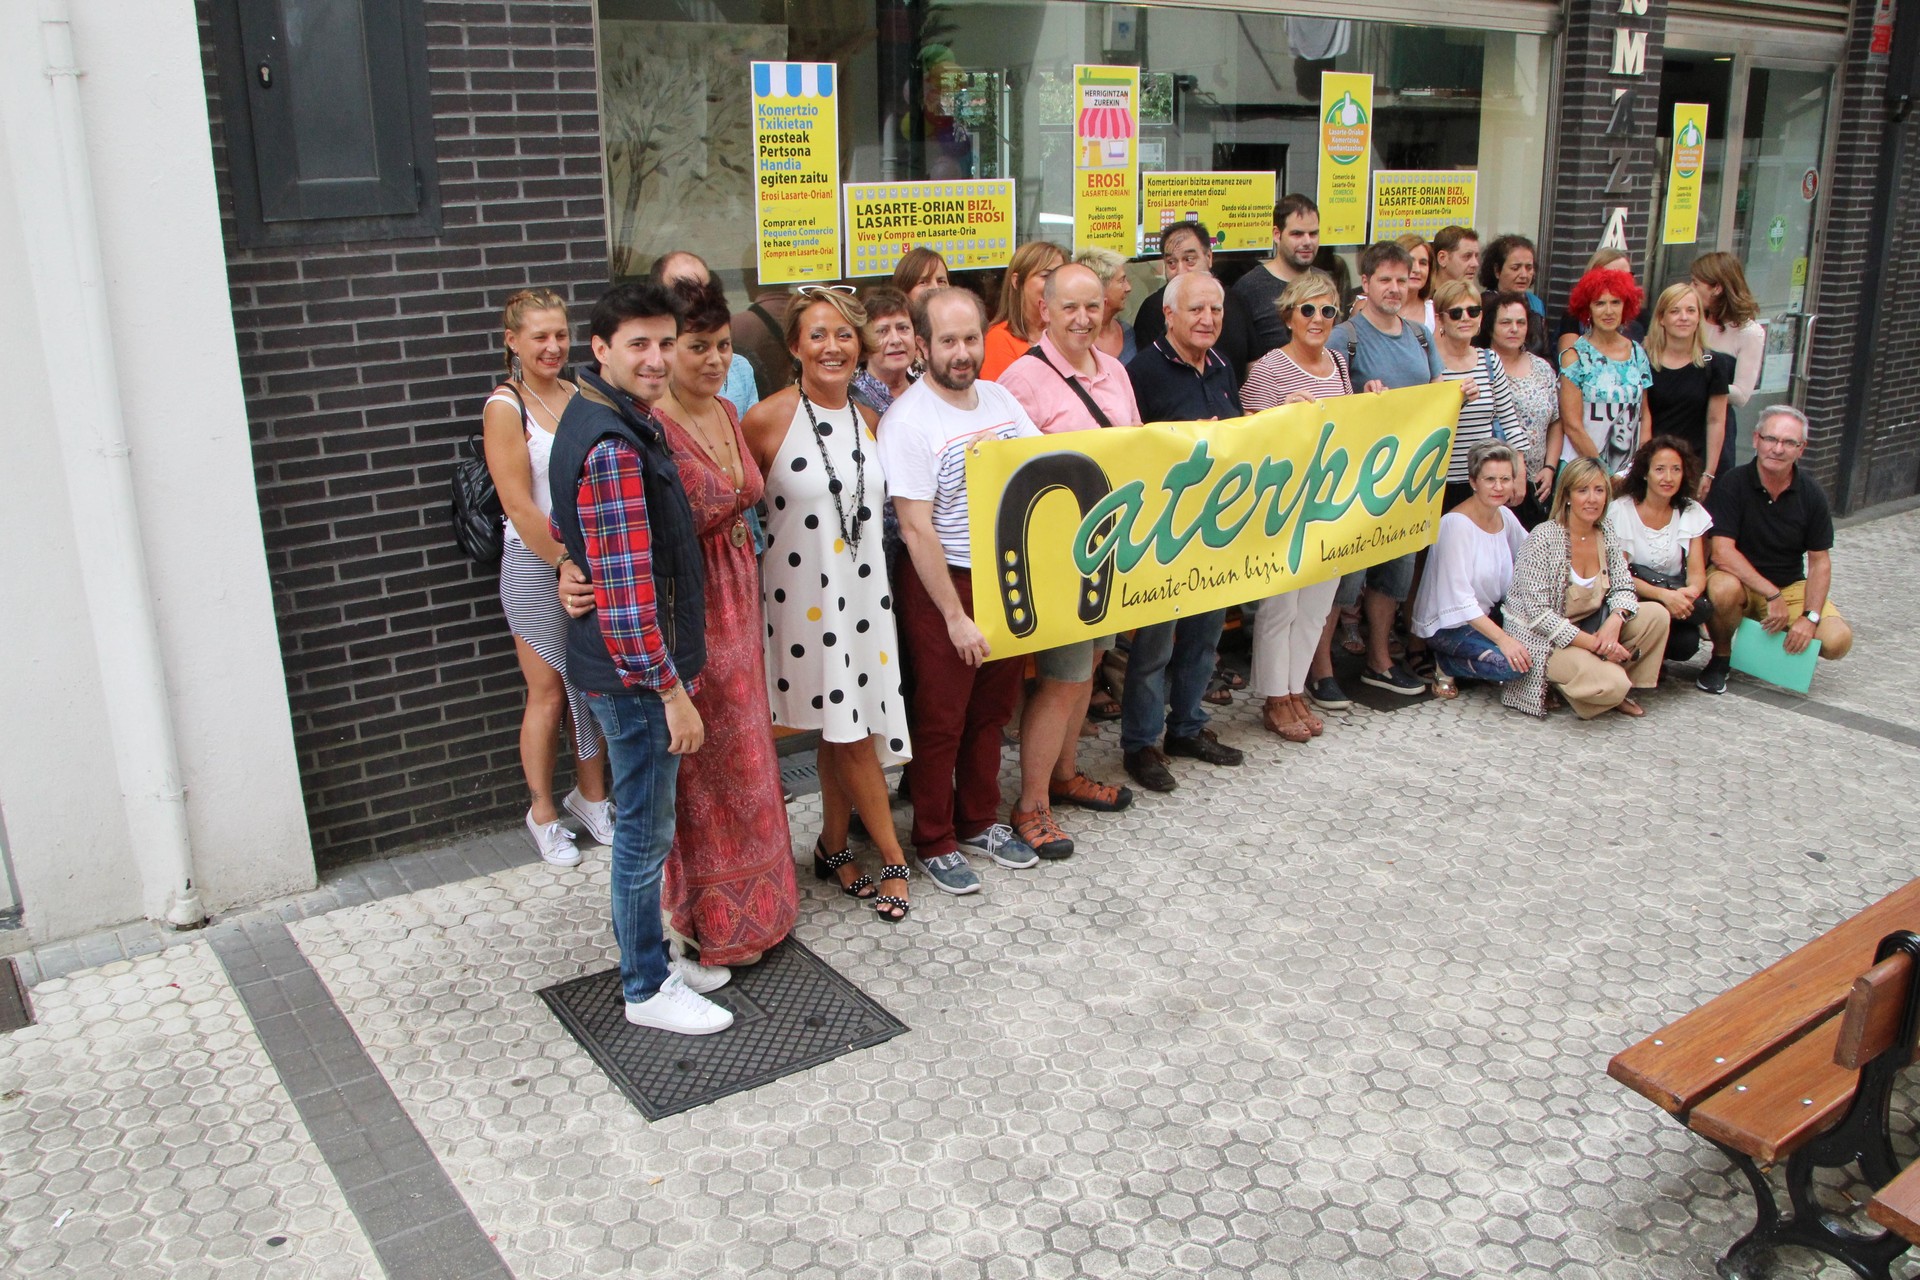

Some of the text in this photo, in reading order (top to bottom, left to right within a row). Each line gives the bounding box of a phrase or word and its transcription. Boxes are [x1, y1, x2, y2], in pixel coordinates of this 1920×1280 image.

[758, 104, 818, 116] Komertzio
[759, 117, 813, 130] Txikietan
[759, 130, 810, 143] erosteak
[760, 145, 811, 157] Pertsona
[760, 158, 802, 171] Handia
[761, 171, 828, 188] egiten zaitu
[1088, 174, 1124, 188] EROSI
[1148, 178, 1188, 187] Komertzioari
[1190, 177, 1210, 186] bizitza
[761, 190, 833, 201] Erosi Lasarte-Orian!
[1148, 188, 1171, 197] herriari
[1380, 187, 1464, 196] LASARTE-ORIAN BIZI,
[1148, 198, 1208, 208] Erosi Lasarte-Orian!
[1379, 197, 1469, 206] LASARTE-ORIAN EROSI
[856, 200, 996, 216] LASARTE-ORIAN BIZI,
[1395, 208, 1414, 216] Compra
[763, 219, 796, 228] Comprar
[808, 217, 816, 225] el
[857, 212, 1005, 229] LASARTE-ORIAN EROSI
[764, 227, 834, 239] Pequeño Comercio
[1090, 222, 1121, 232] ¡COMPRA
[858, 232, 876, 241] Vive
[877, 233, 882, 242] y
[884, 230, 915, 240] Compra
[928, 226, 976, 237] Lasarte-Oria
[773, 239, 791, 247] hace
[792, 238, 819, 248] grande
[764, 250, 788, 259] ¡Compra
[797, 248, 834, 256] Lasarte-Oria!
[1590, 385, 1642, 422] LOV
[1321, 525, 1406, 562] Lasarte-Orian
[1122, 552, 1284, 608] Lasarte-Orian bizi,
